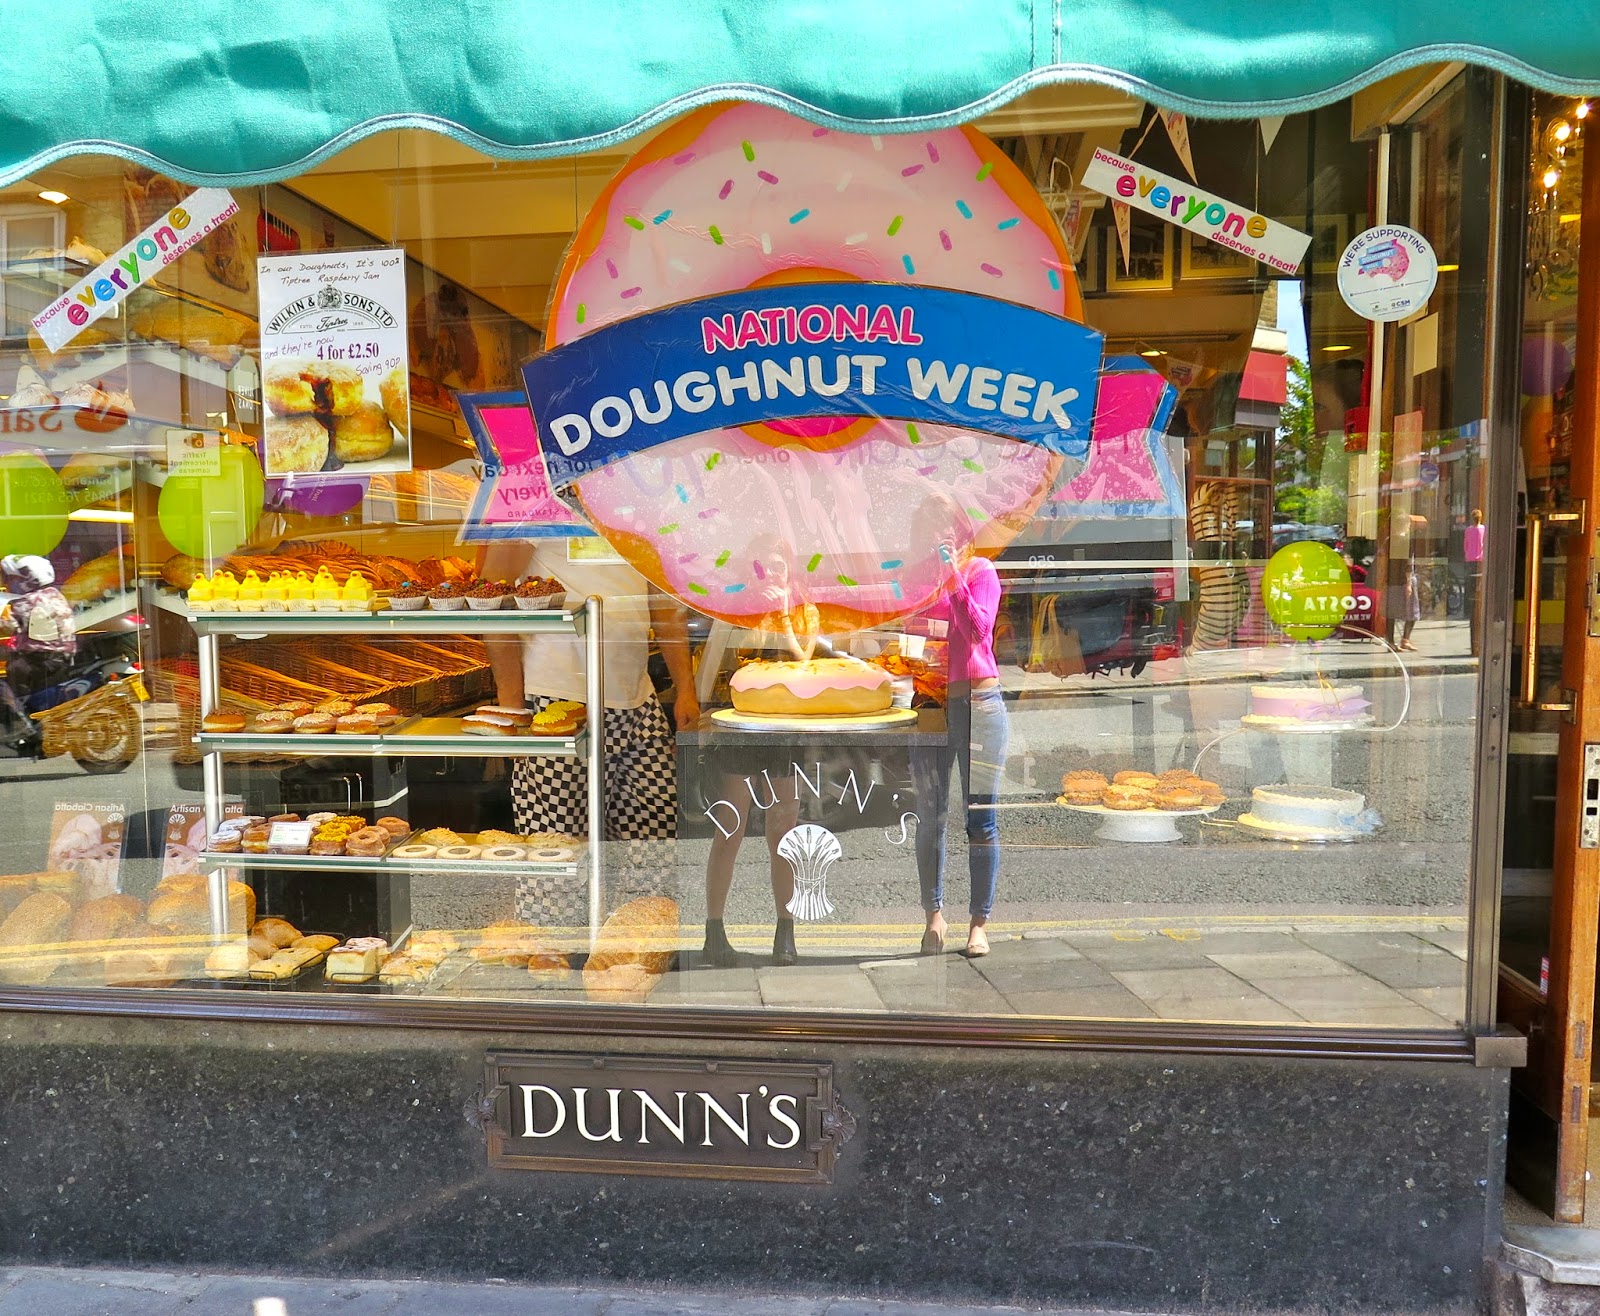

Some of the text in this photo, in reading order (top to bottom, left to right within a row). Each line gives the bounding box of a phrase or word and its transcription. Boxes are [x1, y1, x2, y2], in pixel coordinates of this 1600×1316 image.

[1094, 150, 1136, 173] because
[1116, 174, 1267, 239] everyone
[162, 202, 240, 265] deserves a treat!
[1212, 231, 1298, 274] deserves a treat!
[1343, 229, 1427, 268] WE'RE SUPPORTING
[67, 206, 192, 326] everyone
[260, 266, 271, 274] In
[300, 262, 349, 274] Doughnuts,
[356, 257, 375, 268] It's
[281, 271, 380, 287] Tiptree Raspberry Jam
[32, 297, 70, 329] because
[269, 299, 306, 332] WILKIN
[307, 297, 316, 307] &
[344, 294, 373, 312] SONS
[374, 308, 394, 327] LTD
[316, 315, 349, 332] Tiptree
[701, 303, 923, 354] NATIONAL
[264, 348, 279, 360] and
[315, 335, 335, 346] now
[317, 342, 380, 360] 4 for £2.50
[355, 362, 383, 376] Saving
[549, 354, 1080, 458] DOUGHNUT WEEK
[170, 804, 201, 813] Artisan
[703, 761, 921, 845] DUNN'S
[517, 1083, 801, 1150] DUNN'S
